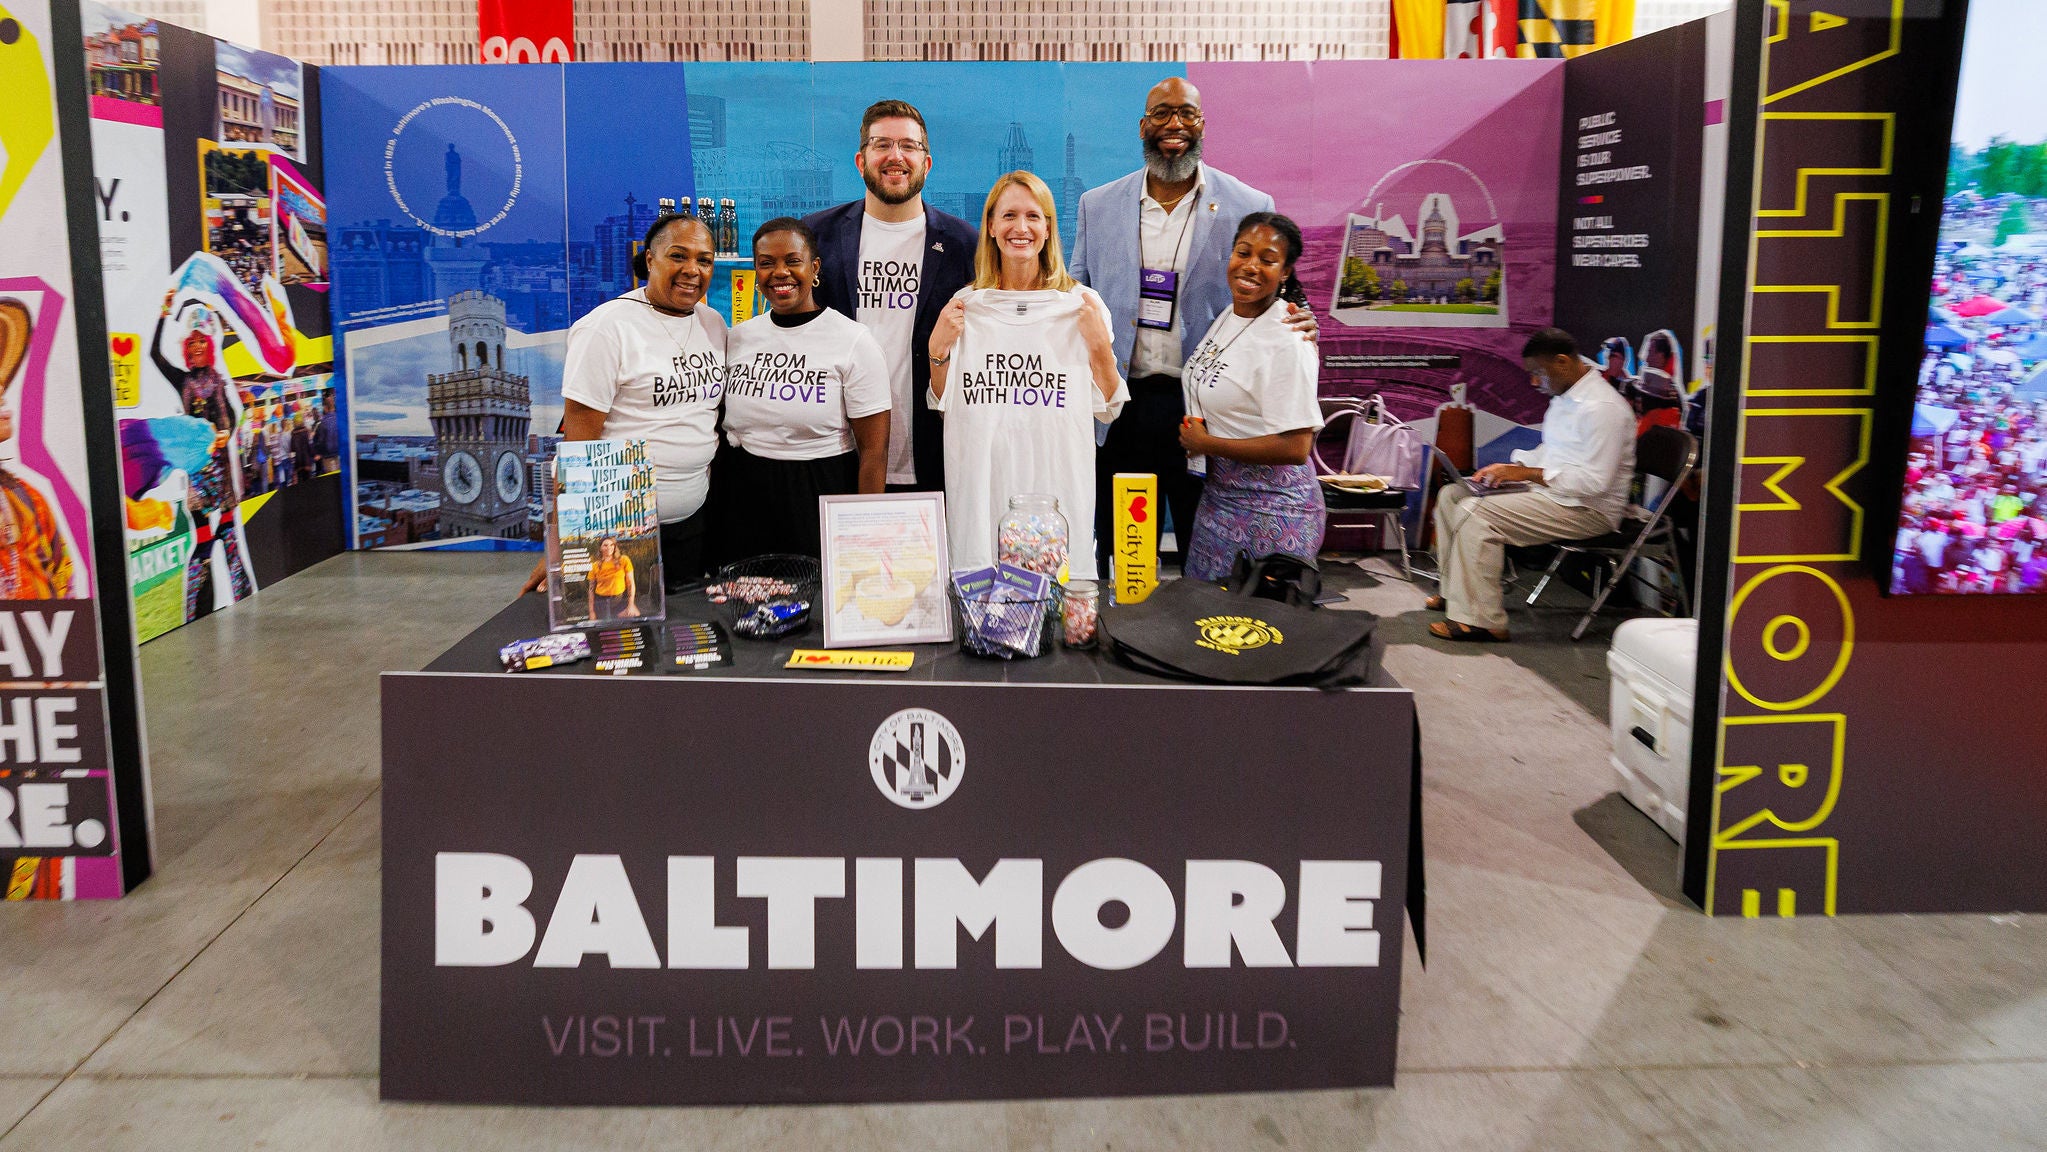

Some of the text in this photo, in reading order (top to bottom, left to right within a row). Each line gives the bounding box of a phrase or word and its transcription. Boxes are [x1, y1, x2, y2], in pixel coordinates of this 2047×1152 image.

[1579, 111, 1616, 130] PUBLIC
[1578, 129, 1622, 149] SERVICE
[1576, 165, 1652, 186] SUPERPOWER.
[1573, 217, 1595, 230] NOT
[1573, 234, 1649, 248] SUPERHEROES
[863, 261, 918, 277] FROM
[888, 293, 914, 309] LO
[672, 351, 718, 373] FROM
[753, 352, 807, 368] FROM
[986, 354, 1042, 370] FROM
[732, 363, 828, 385] BALTIMORE
[963, 371, 1066, 389] BALTIMORE
[653, 389, 697, 407] WITH
[728, 379, 826, 403] WITH LOVE
[963, 388, 1066, 408] WITH LOVE
[585, 443, 611, 461] VISIT
[592, 468, 618, 487] VISIT
[584, 495, 610, 513] VISIT
[584, 492, 646, 535] BALTIMORE
[1121, 524, 1142, 560] city
[1127, 563, 1146, 595] life
[906, 712, 961, 754] BALTIMORE
[434, 851, 1382, 970] BALTIMORE
[541, 1010, 1298, 1057] VISIT. LIVE. WORK. PLAY. BUILD.
